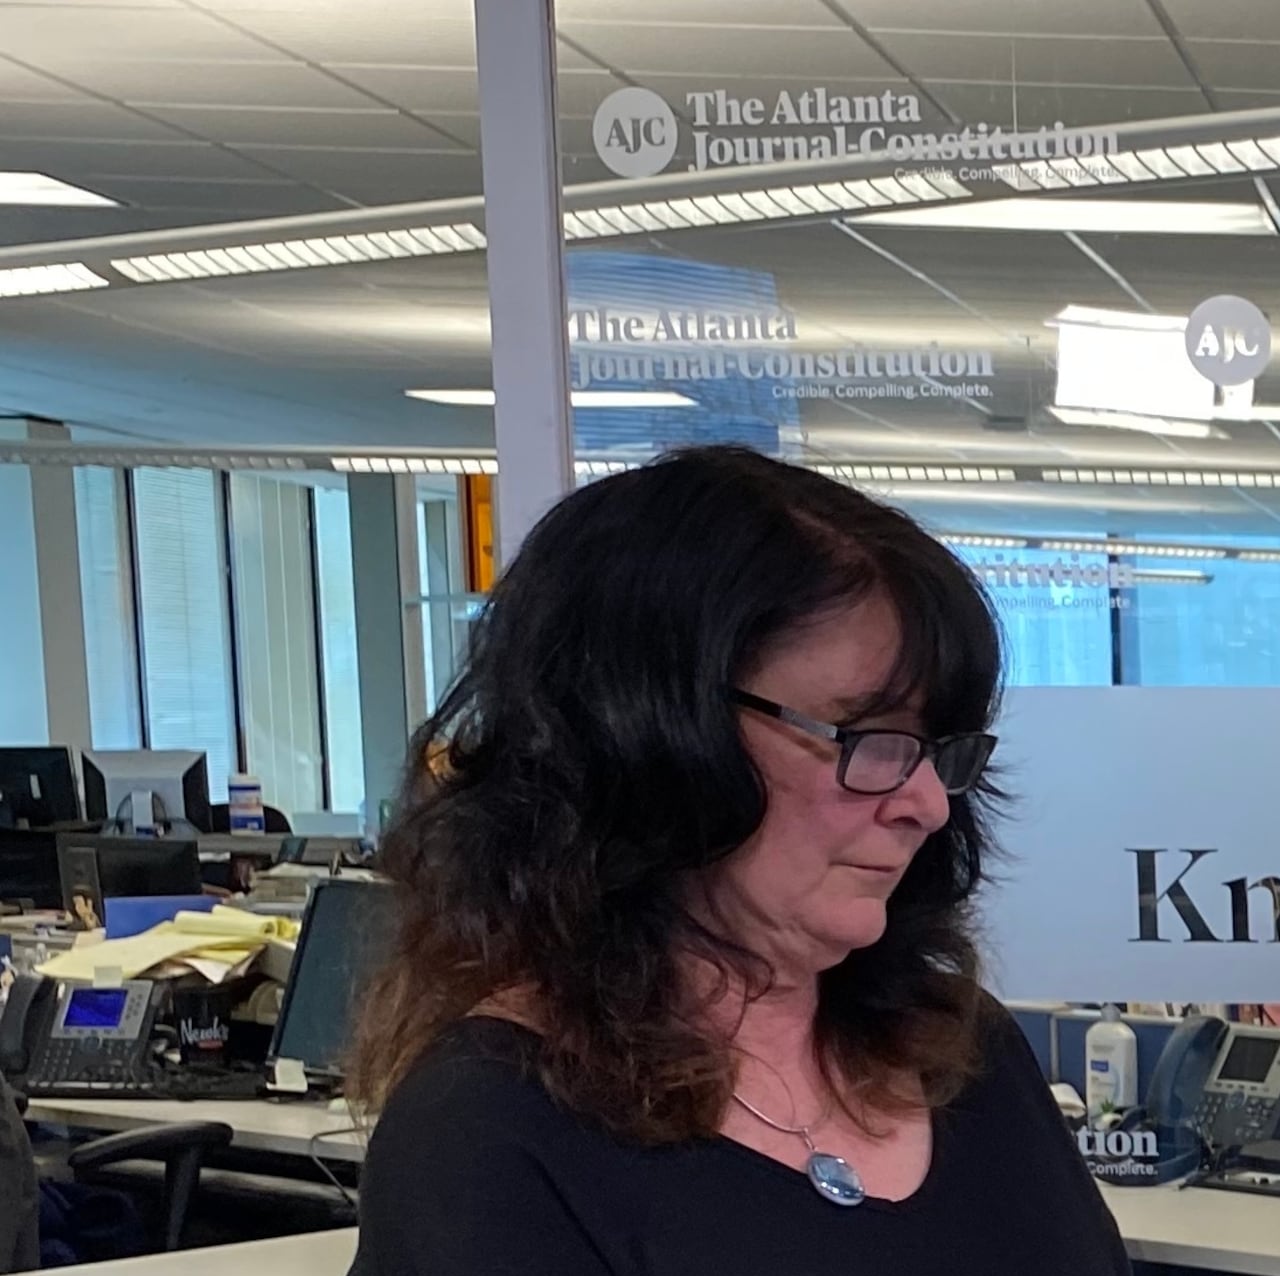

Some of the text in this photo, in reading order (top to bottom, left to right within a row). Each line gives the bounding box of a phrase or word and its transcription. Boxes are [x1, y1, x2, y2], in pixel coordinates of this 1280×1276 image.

[687, 87, 921, 126] The Atlanta
[605, 117, 665, 153] AJC
[687, 121, 1119, 173] Journal-Constitution
[569, 308, 798, 342] The Atlanta
[1194, 323, 1260, 361] AJC
